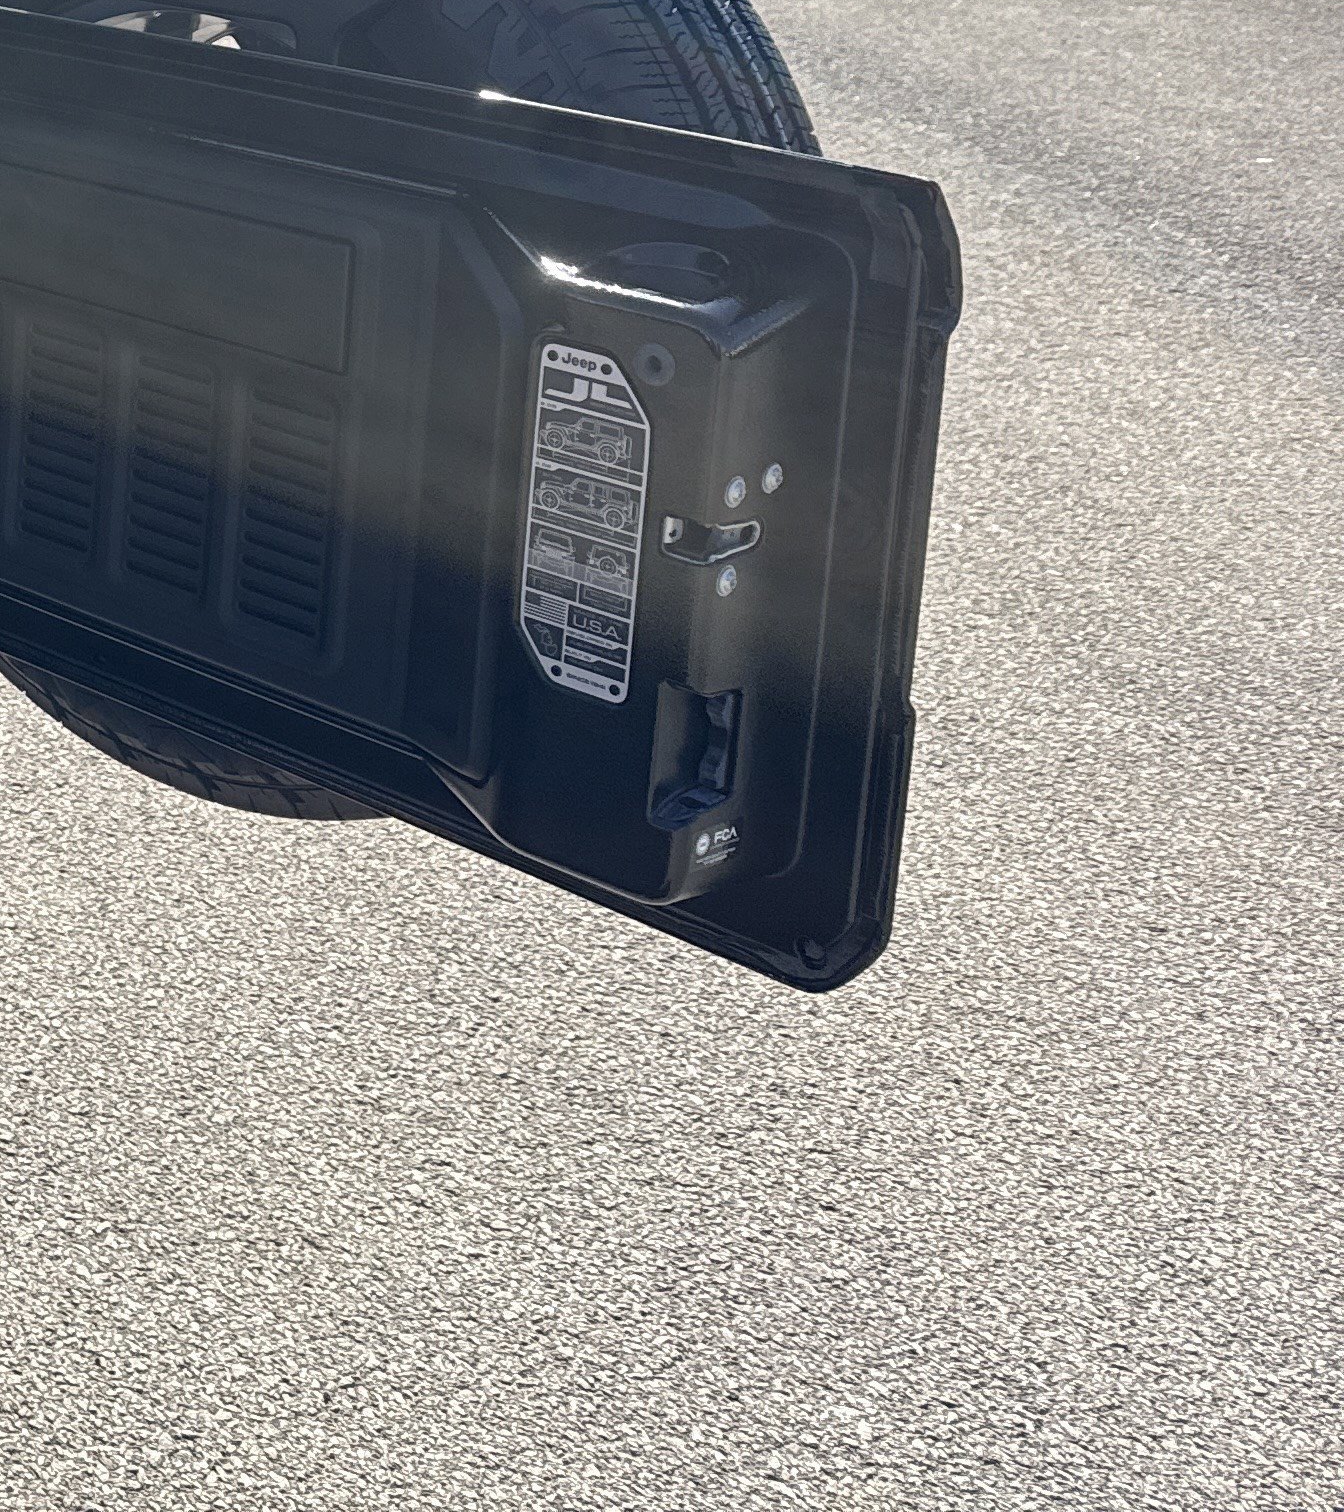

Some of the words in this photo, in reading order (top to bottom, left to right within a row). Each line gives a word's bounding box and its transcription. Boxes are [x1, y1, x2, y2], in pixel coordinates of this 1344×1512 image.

[561, 352, 597, 372] Jeep
[544, 377, 633, 409] JL
[713, 825, 739, 844] FCA
